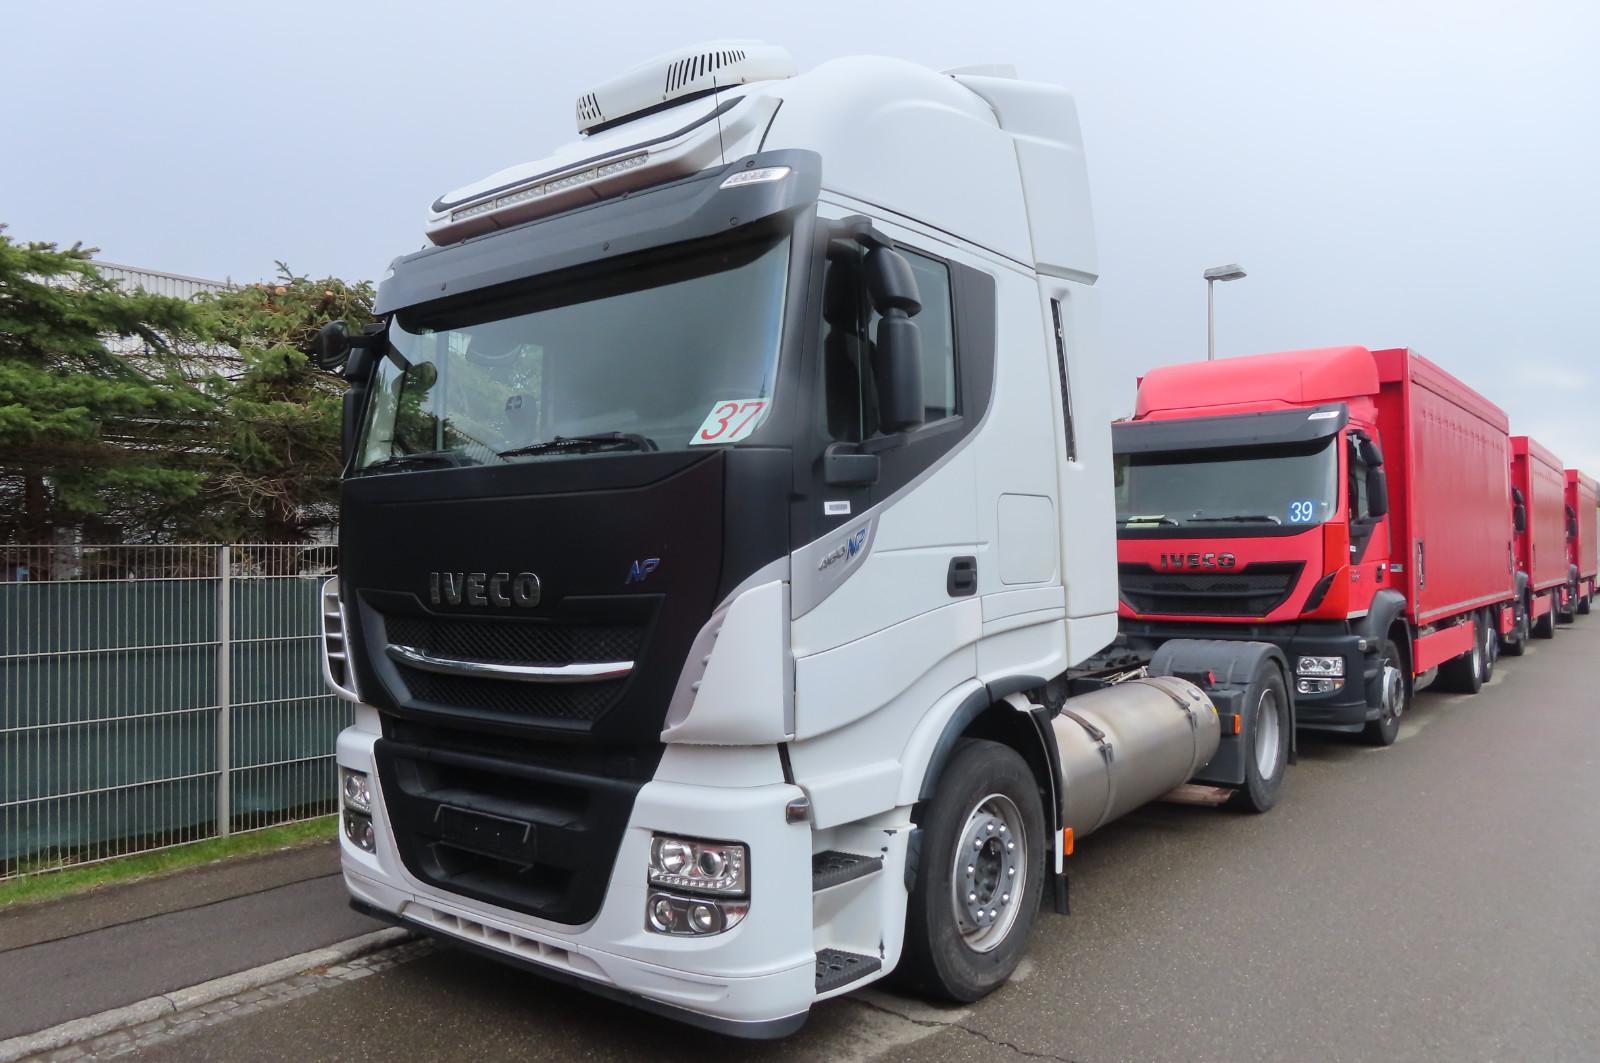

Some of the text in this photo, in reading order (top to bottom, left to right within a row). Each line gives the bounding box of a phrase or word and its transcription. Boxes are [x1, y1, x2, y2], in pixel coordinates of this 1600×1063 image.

[700, 401, 767, 441] 37
[1290, 501, 1313, 522] 39
[625, 557, 661, 585] NP
[1160, 552, 1236, 569] IVECO
[429, 571, 542, 608] IVECO
